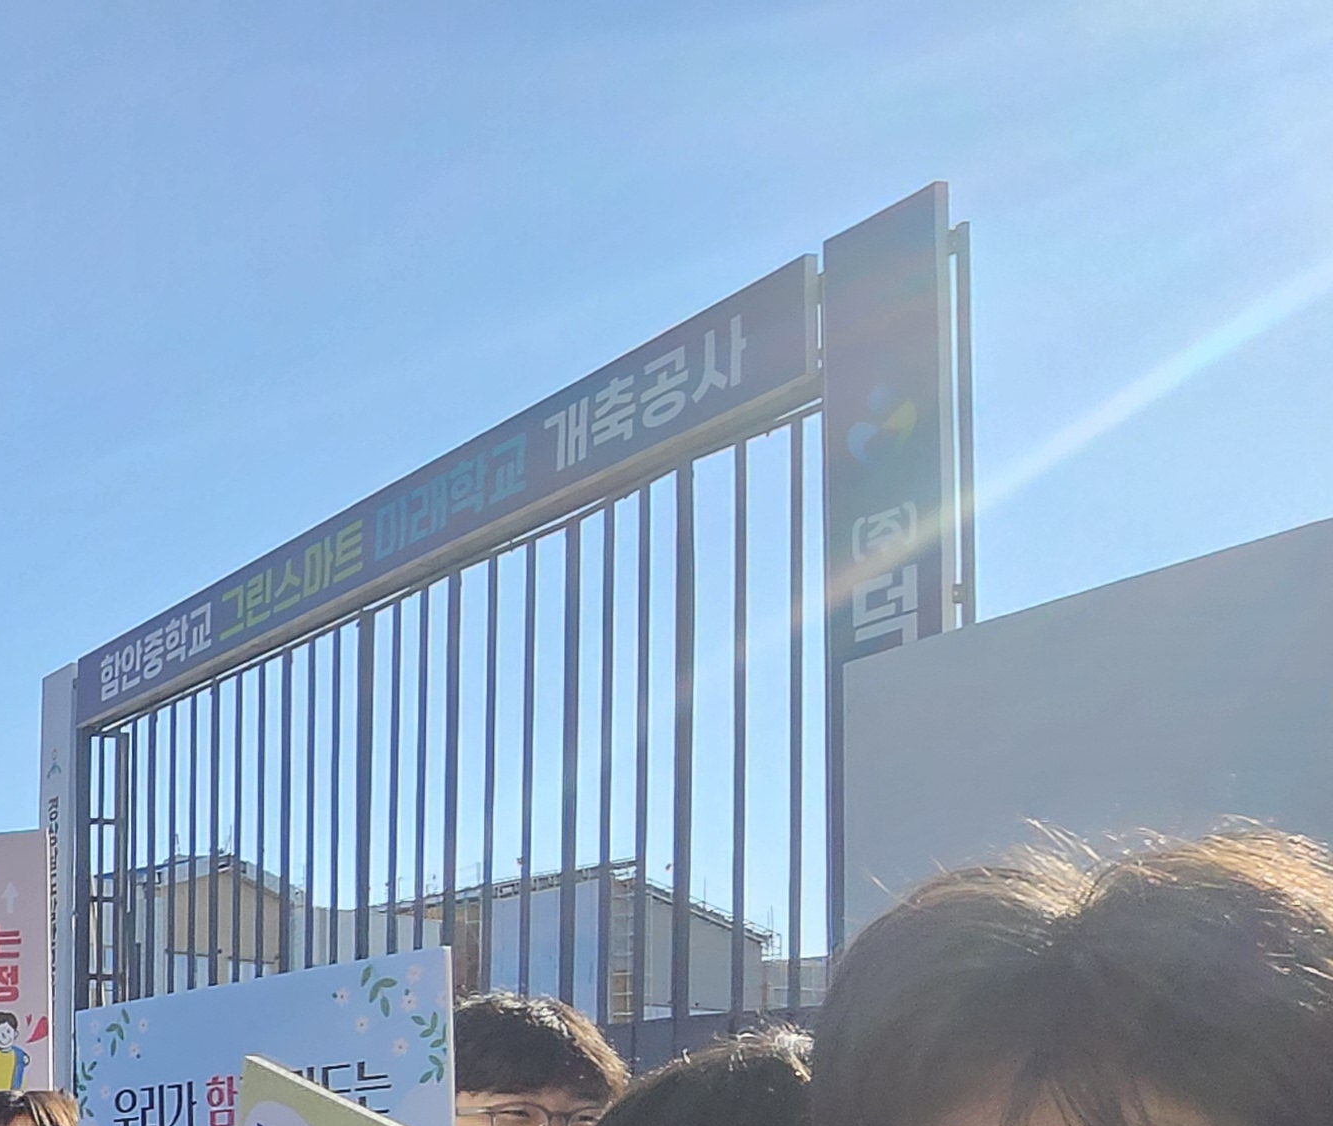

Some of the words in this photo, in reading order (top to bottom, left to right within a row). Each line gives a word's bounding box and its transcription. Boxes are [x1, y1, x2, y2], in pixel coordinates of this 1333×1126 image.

[99, 603, 213, 702] 함안중학교
[220, 519, 363, 642] 그린스마트
[374, 431, 527, 563] 미래학교
[545, 314, 747, 472] 개축공사
